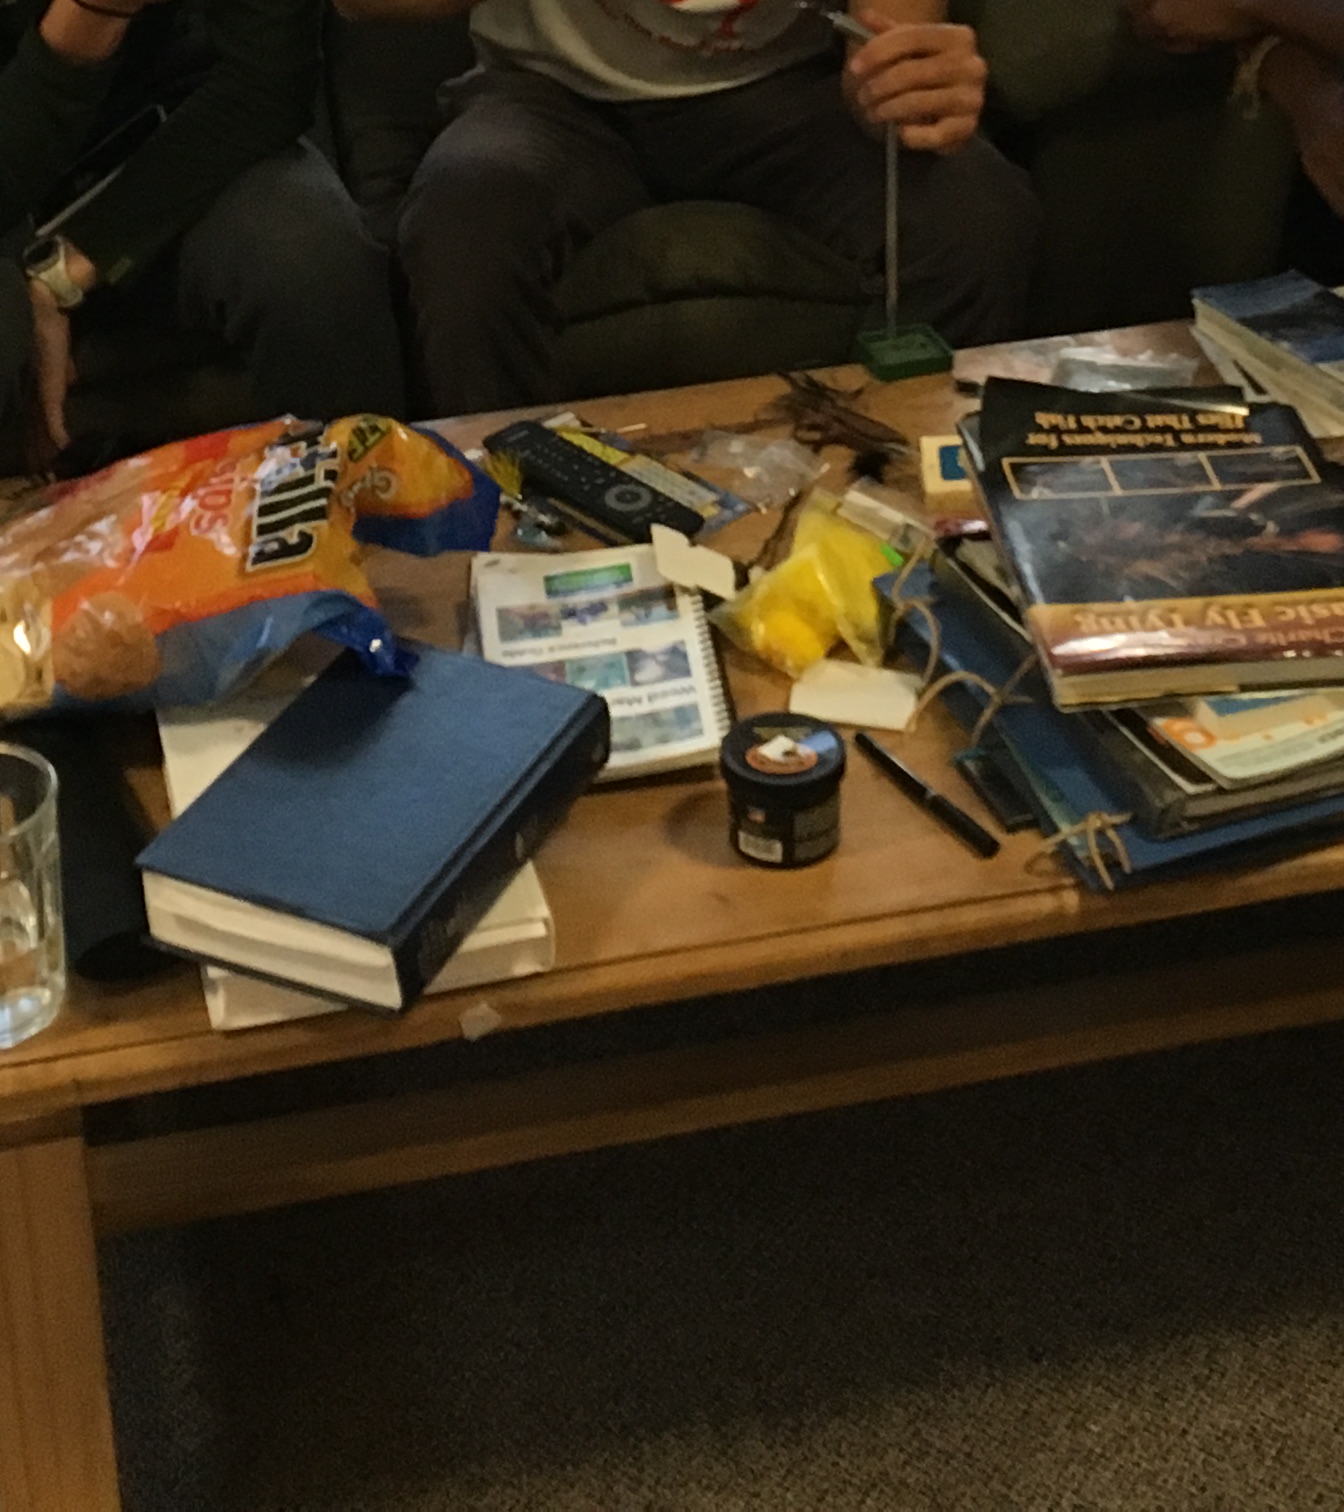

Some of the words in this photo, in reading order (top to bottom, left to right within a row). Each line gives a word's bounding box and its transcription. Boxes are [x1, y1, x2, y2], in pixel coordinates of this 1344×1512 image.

[1034, 410, 1077, 430] Fish
[1080, 413, 1143, 431] Catch
[1144, 413, 1192, 430] That
[1025, 431, 1058, 450] for
[1061, 430, 1176, 448] Techniques
[1180, 431, 1263, 446] Modern
[1073, 606, 1185, 631] Tying
[1205, 605, 1266, 629] Fly
